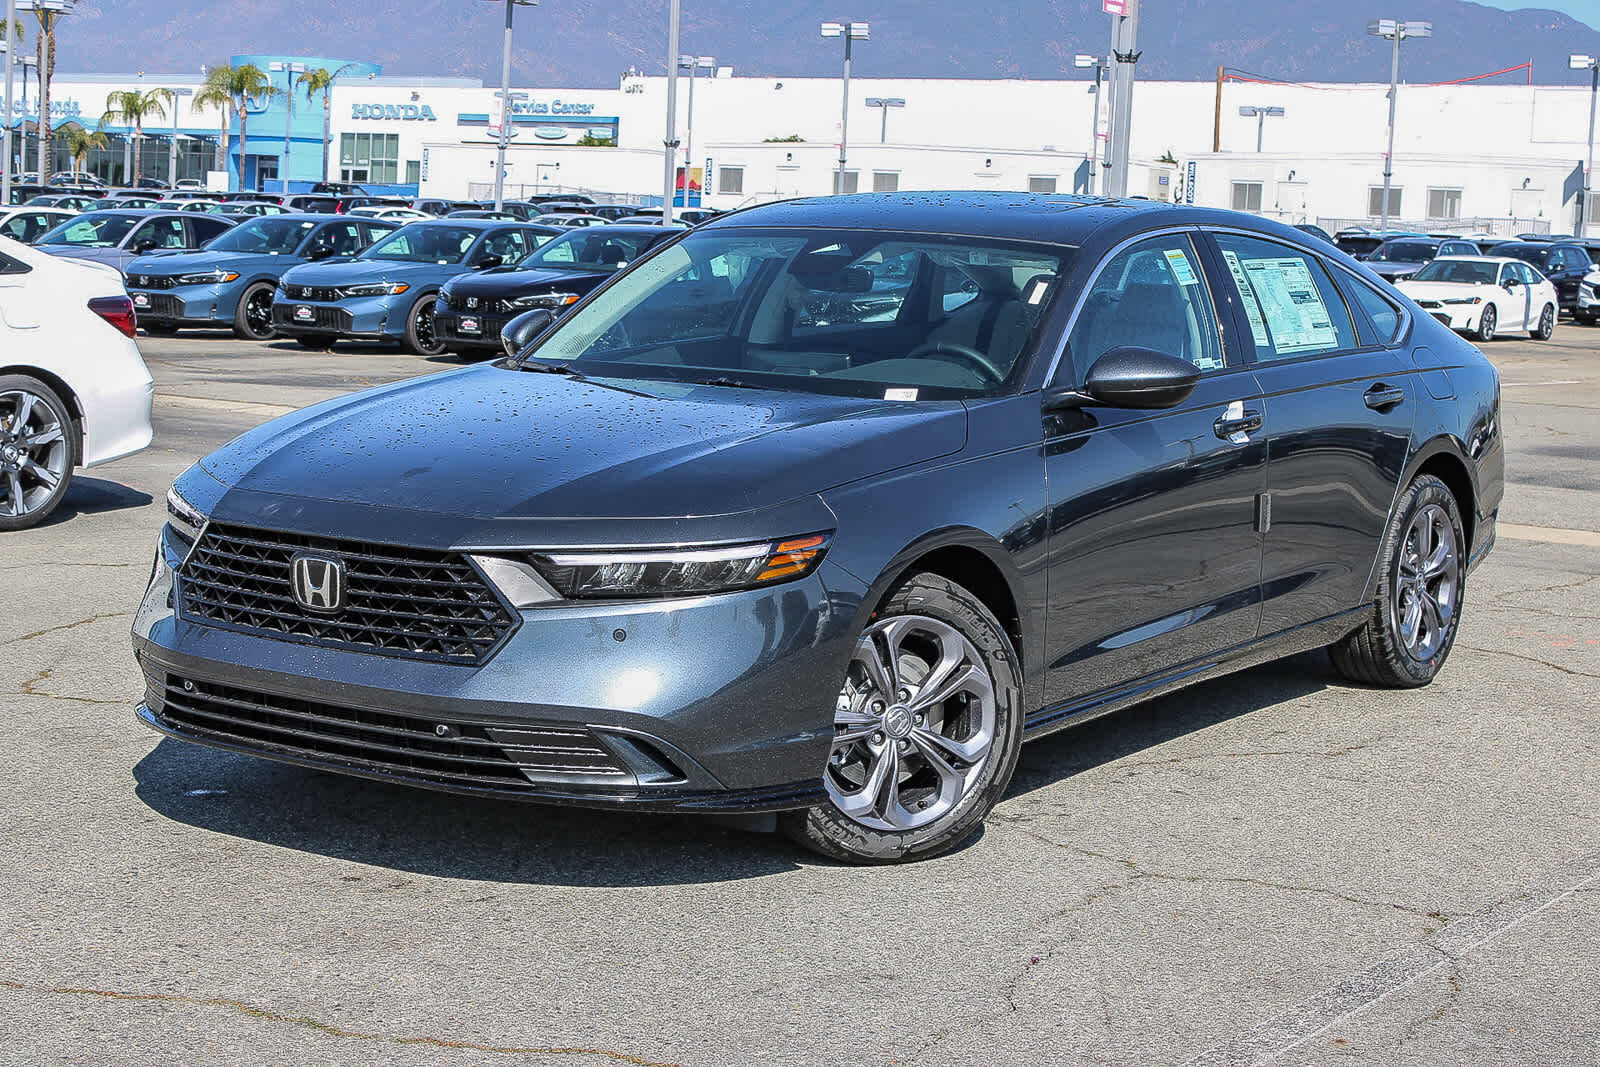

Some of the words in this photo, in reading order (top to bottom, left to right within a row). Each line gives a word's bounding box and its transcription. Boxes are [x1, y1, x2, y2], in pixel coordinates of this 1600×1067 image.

[351, 103, 437, 121] HONDA
[505, 98, 549, 114] ervice
[551, 98, 595, 115] Center
